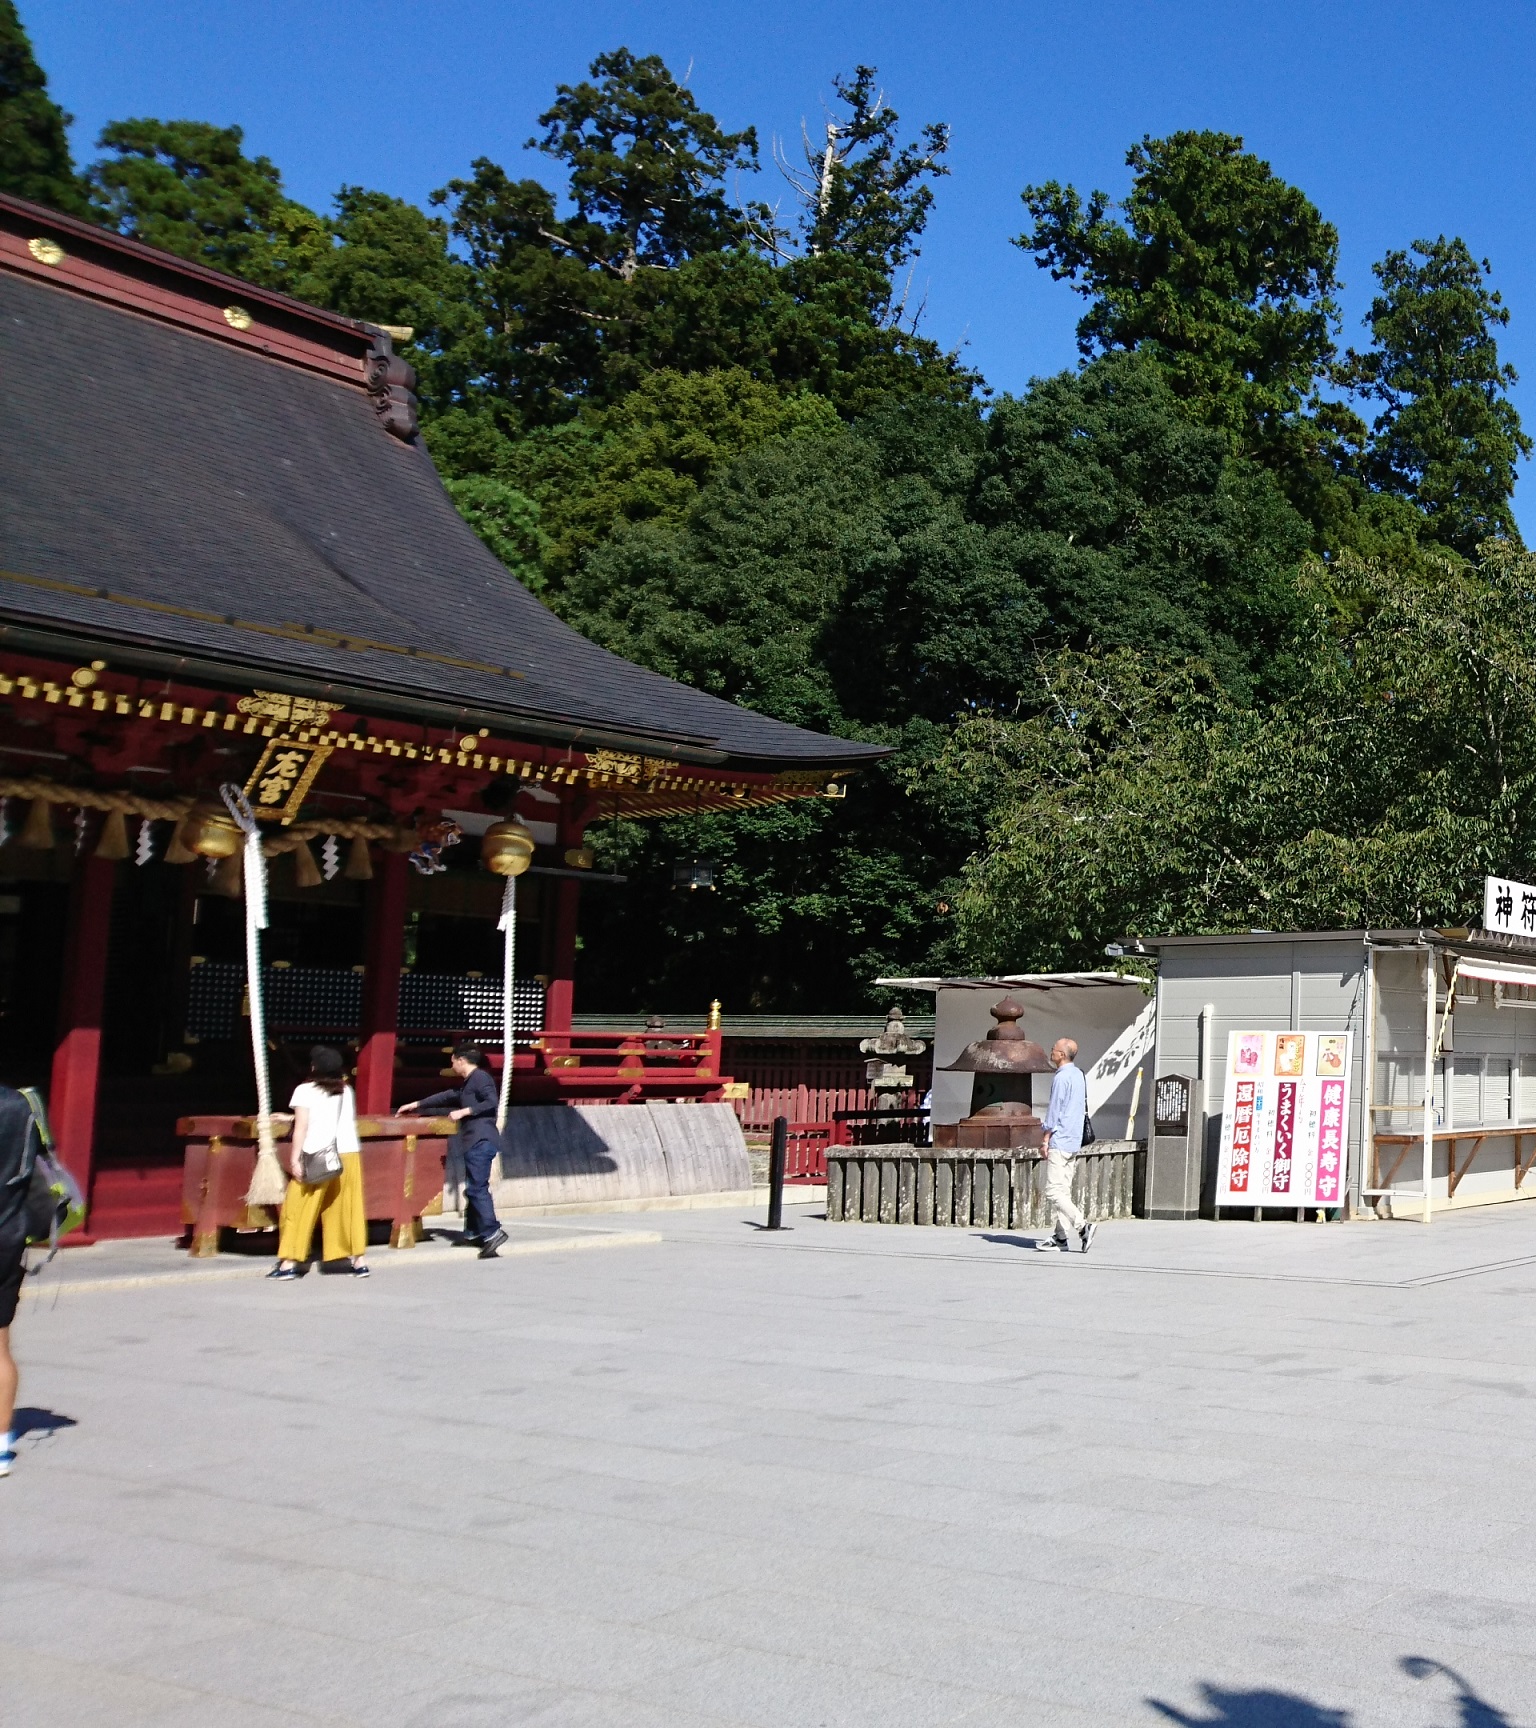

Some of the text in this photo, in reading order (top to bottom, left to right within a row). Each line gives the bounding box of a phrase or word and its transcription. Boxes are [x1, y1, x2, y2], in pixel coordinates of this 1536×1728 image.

[1231, 1083, 1254, 1188] 還暦厄除守
[1273, 1083, 1292, 1191] うまくいく御守
[1318, 1083, 1343, 1198] 健康長寿守
